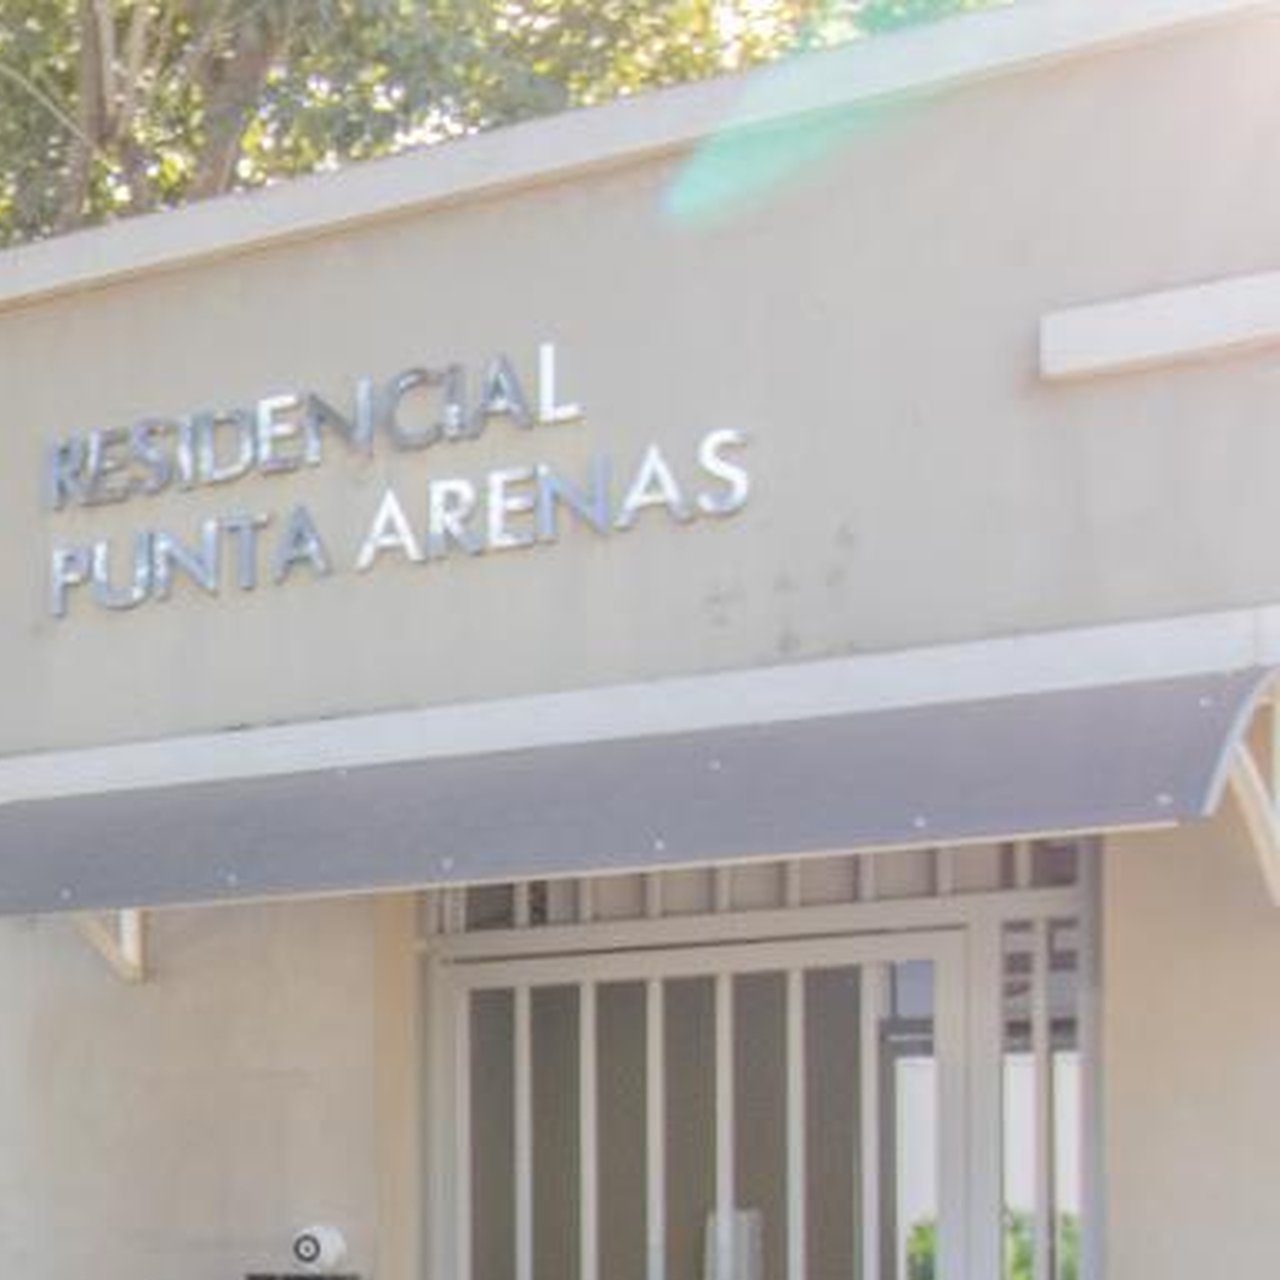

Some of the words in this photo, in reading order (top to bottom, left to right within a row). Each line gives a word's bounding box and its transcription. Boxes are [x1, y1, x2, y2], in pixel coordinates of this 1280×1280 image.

[49, 342, 582, 509] RESIDENCIAL
[51, 503, 330, 618] PUNTA
[355, 427, 751, 573] ARENAS
